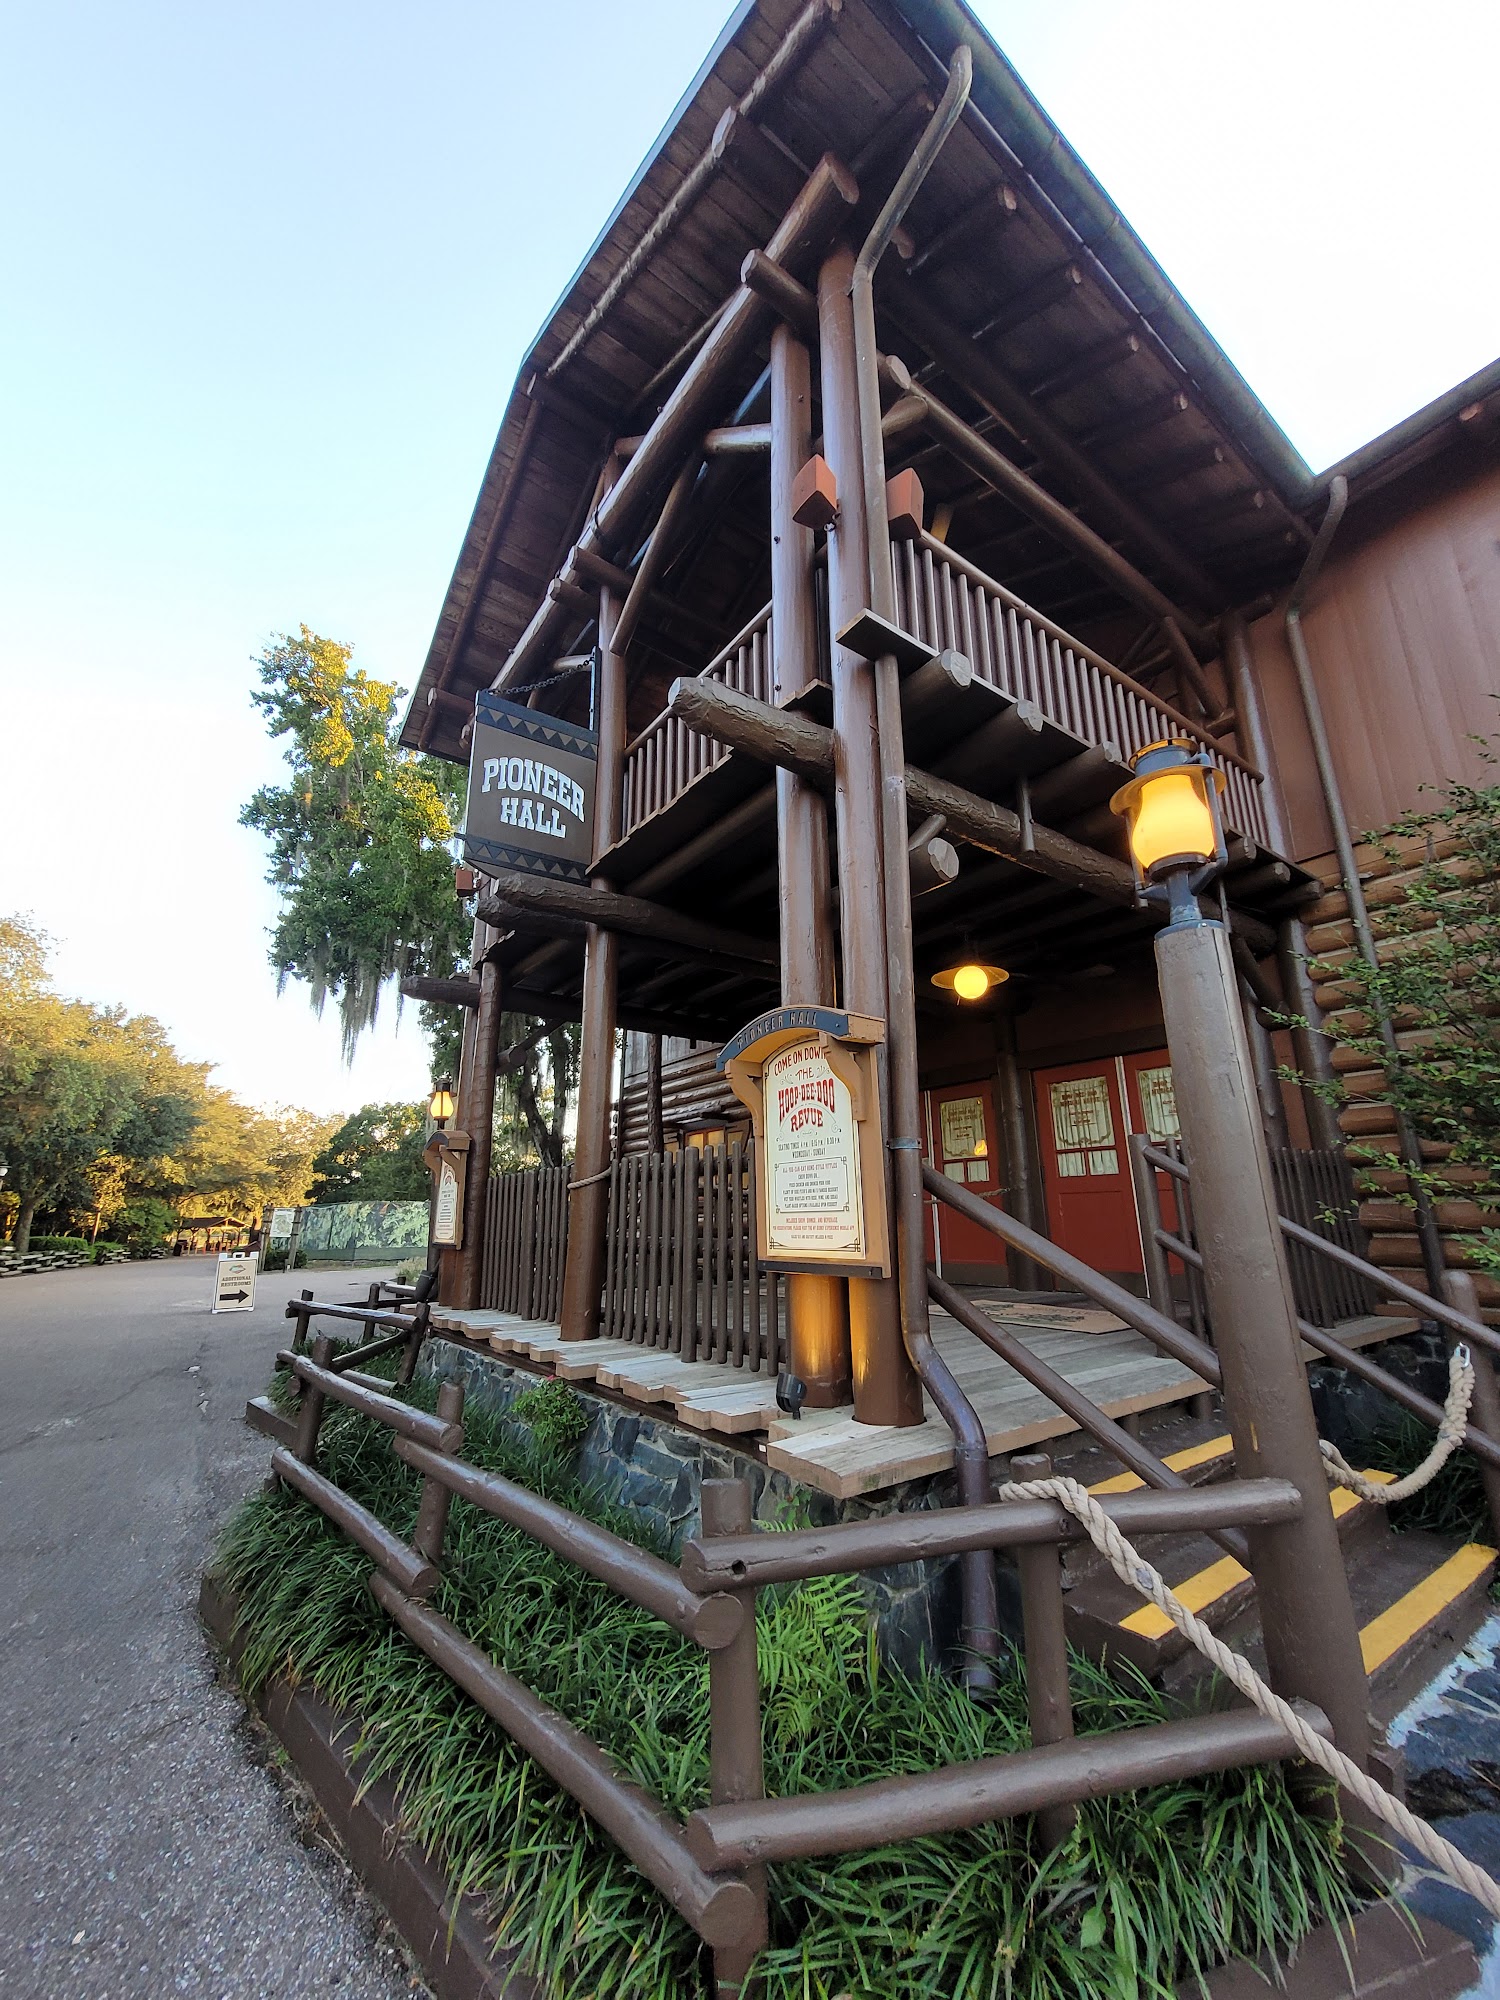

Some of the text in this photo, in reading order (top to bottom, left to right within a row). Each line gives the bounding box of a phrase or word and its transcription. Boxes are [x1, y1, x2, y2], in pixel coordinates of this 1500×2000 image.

[481, 757, 585, 822] PIONEER
[500, 797, 566, 838] HALL
[737, 1011, 817, 1049] PIONEER HALL
[774, 1054, 792, 1076] COME
[793, 1049, 803, 1064] ON
[795, 1067, 814, 1081] THE
[791, 1108, 823, 1132] REVUE
